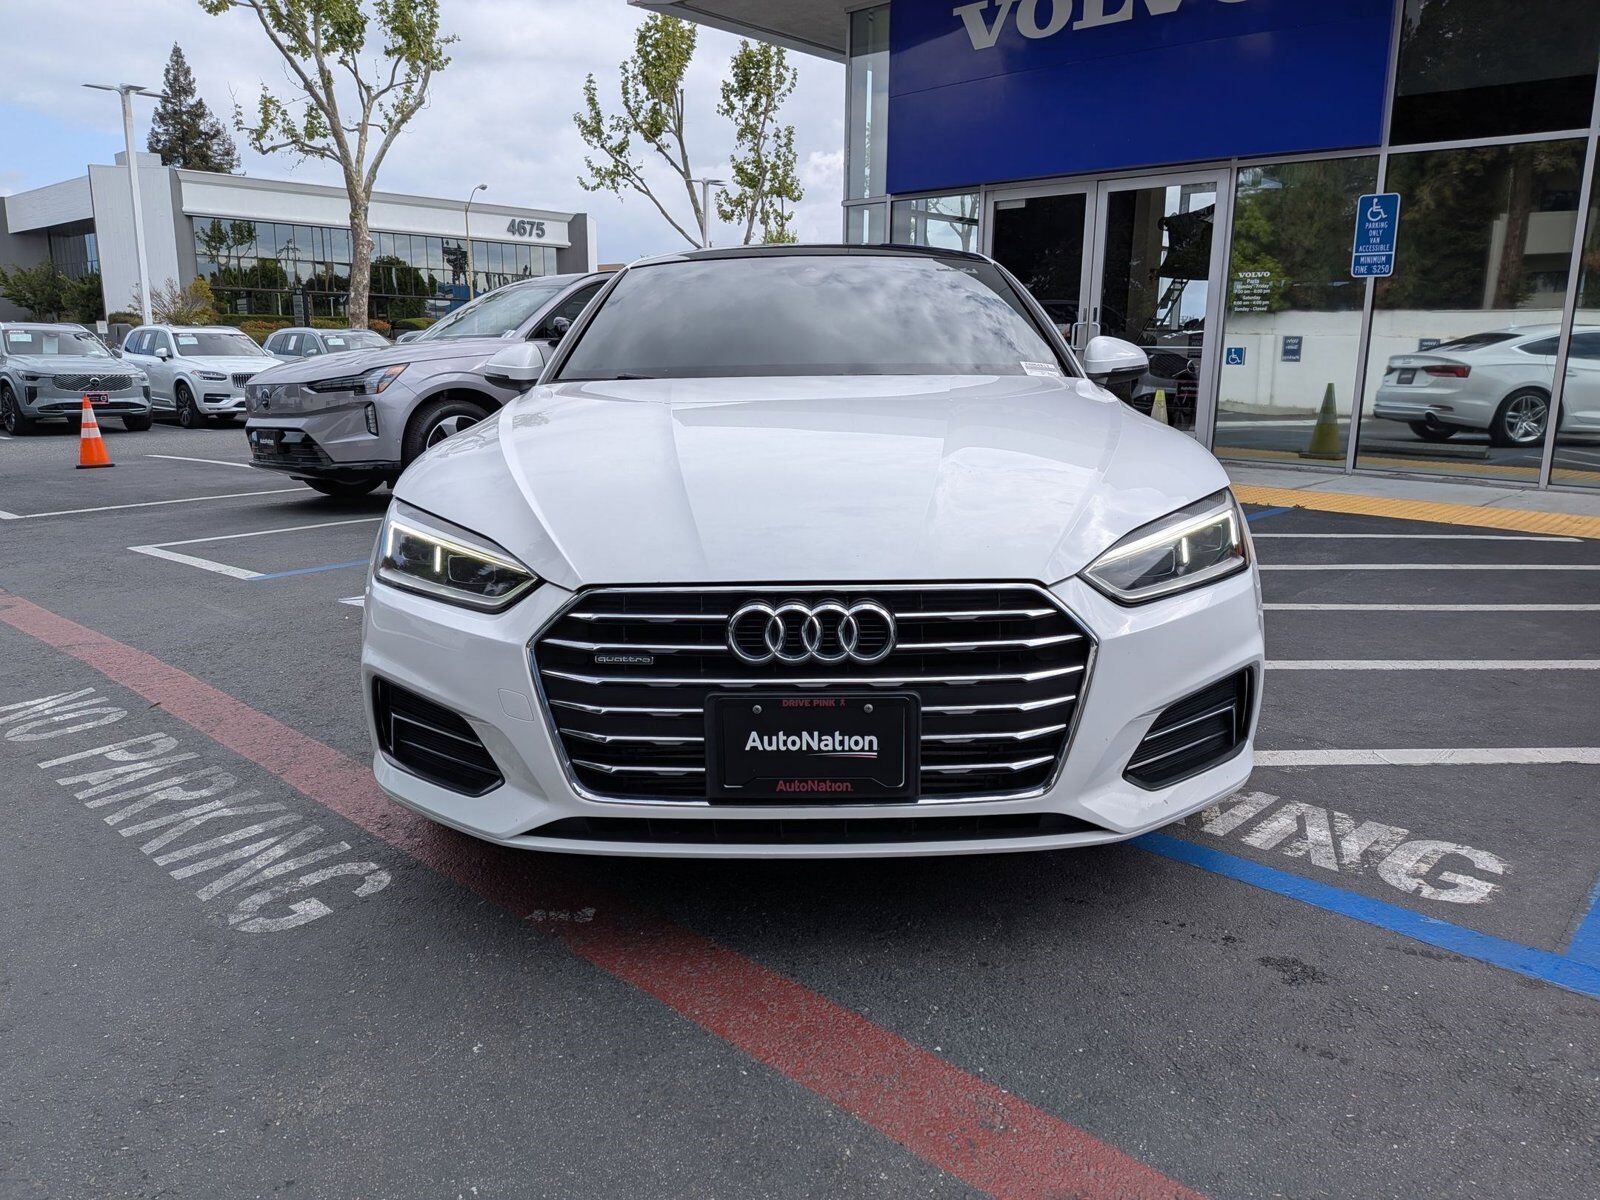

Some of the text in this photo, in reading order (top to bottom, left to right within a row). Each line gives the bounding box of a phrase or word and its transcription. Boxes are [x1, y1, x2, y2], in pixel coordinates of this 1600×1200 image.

[952, 0, 1249, 50] VOL
[507, 218, 546, 239] 4675
[1365, 221, 1389, 229] PARKING
[1368, 229, 1384, 237] ONLY
[1358, 244, 1390, 252] ACCESSIBLE
[1360, 255, 1386, 264] MINIMUM
[1354, 264, 1390, 274] FINE $250
[597, 656, 651, 664] quattro
[782, 699, 835, 707] DRIVE PINK
[745, 731, 878, 751] AutoNation
[776, 780, 851, 792] AutoNation
[37, 731, 392, 933] PARKING
